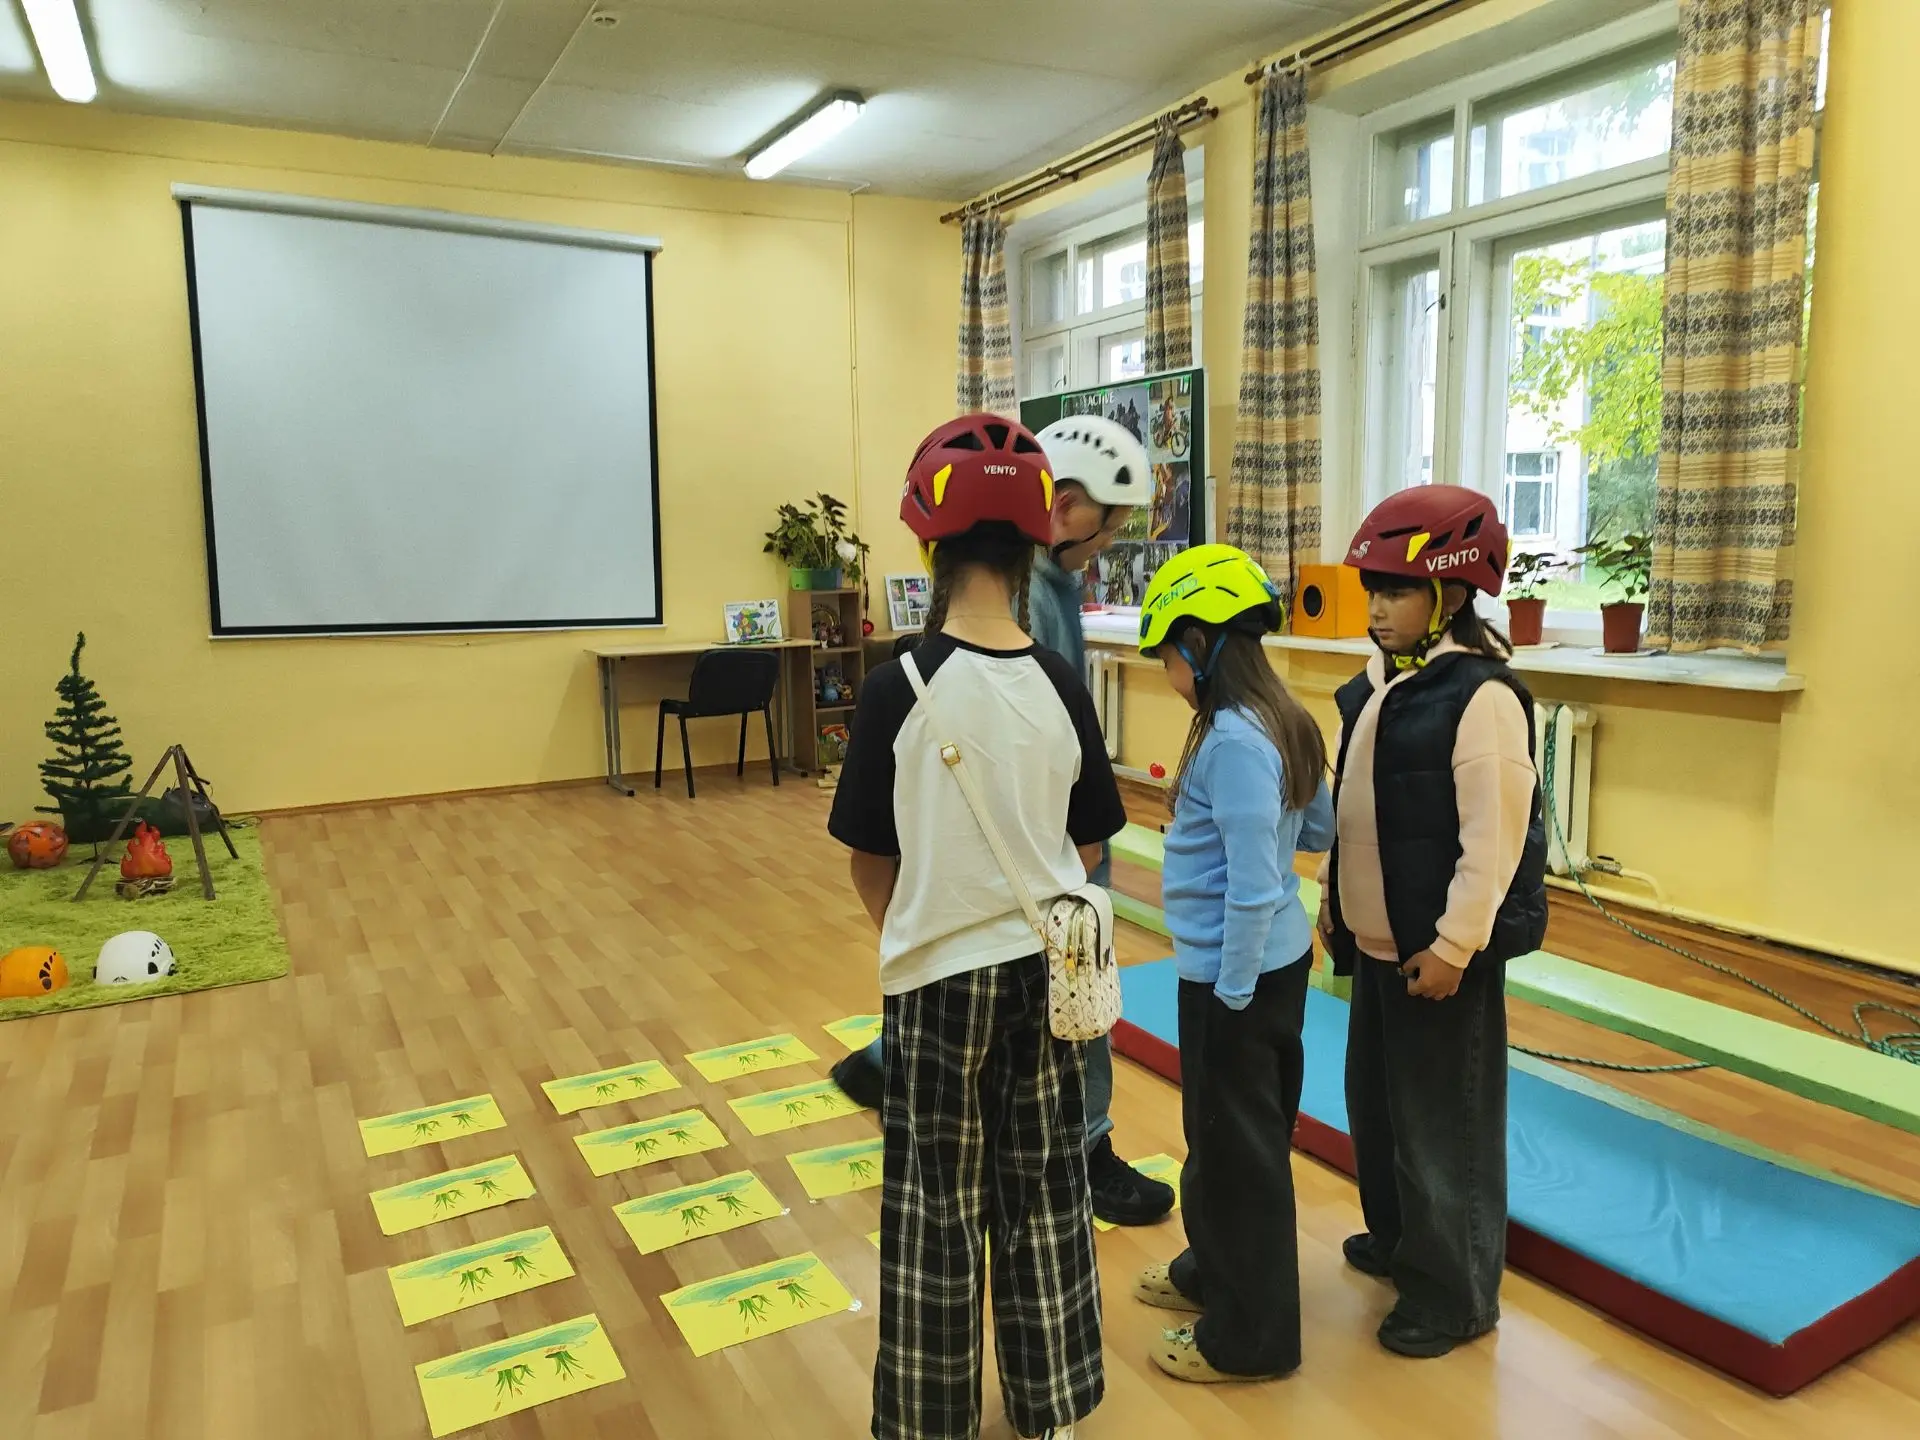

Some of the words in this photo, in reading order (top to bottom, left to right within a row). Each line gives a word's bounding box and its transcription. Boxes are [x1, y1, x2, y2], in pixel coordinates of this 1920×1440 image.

[983, 464, 1017, 476] VENTO
[1425, 546, 1480, 573] VENTO
[1156, 576, 1198, 611] VENTO
